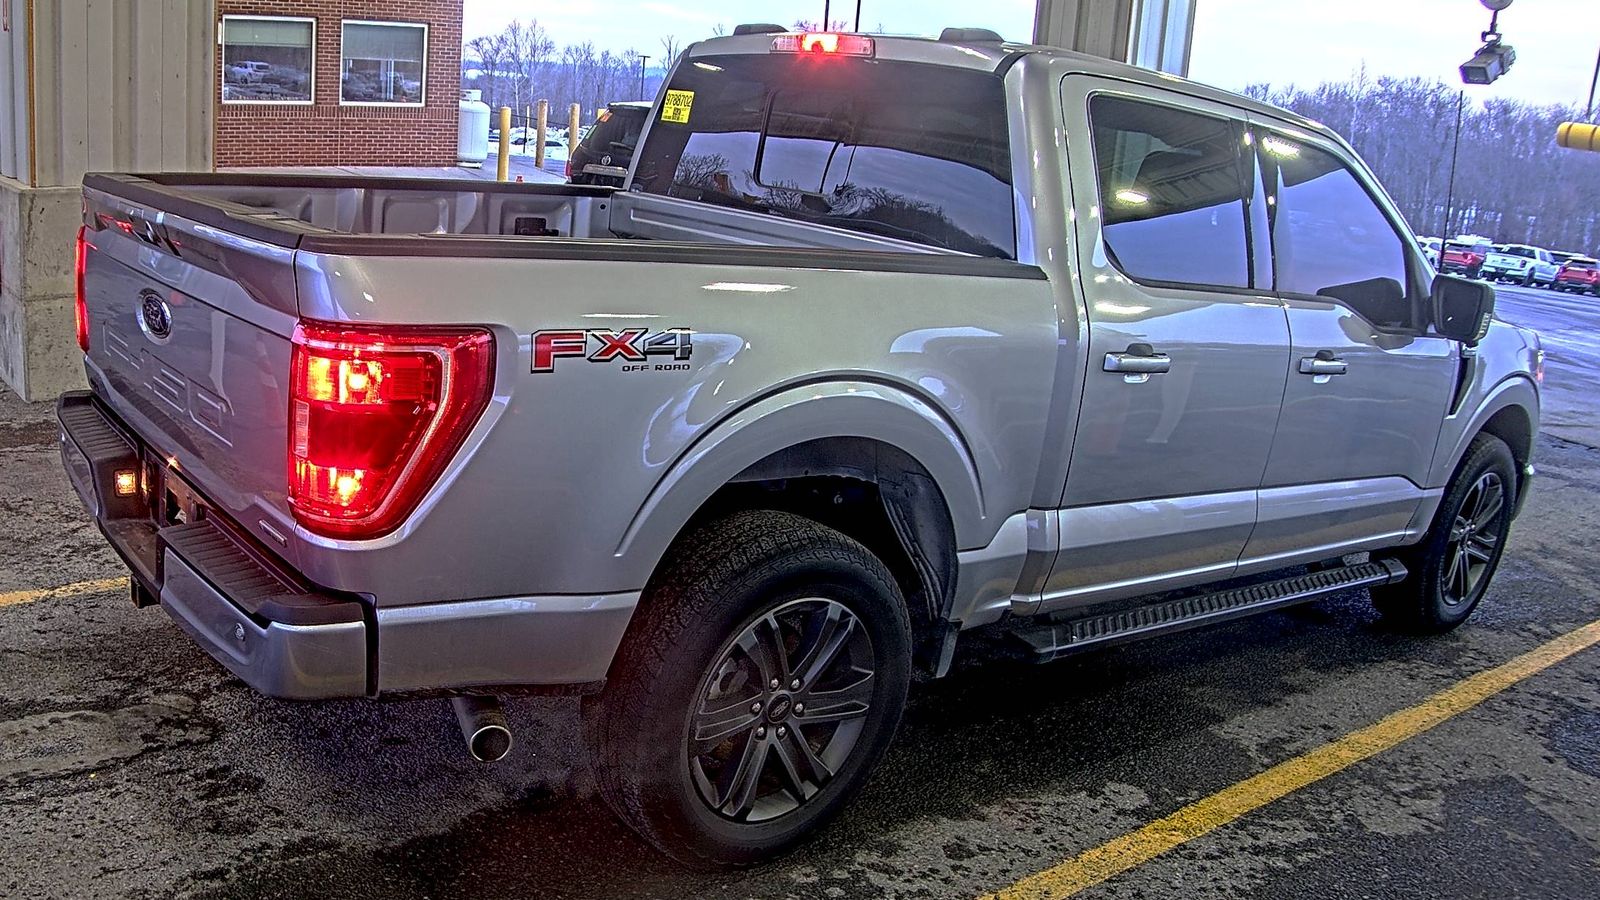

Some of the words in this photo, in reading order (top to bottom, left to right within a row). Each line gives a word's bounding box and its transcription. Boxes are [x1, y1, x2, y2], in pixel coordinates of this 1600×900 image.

[531, 328, 692, 373] FX4
[622, 364, 650, 372] OFF
[655, 363, 691, 371] ROAD
